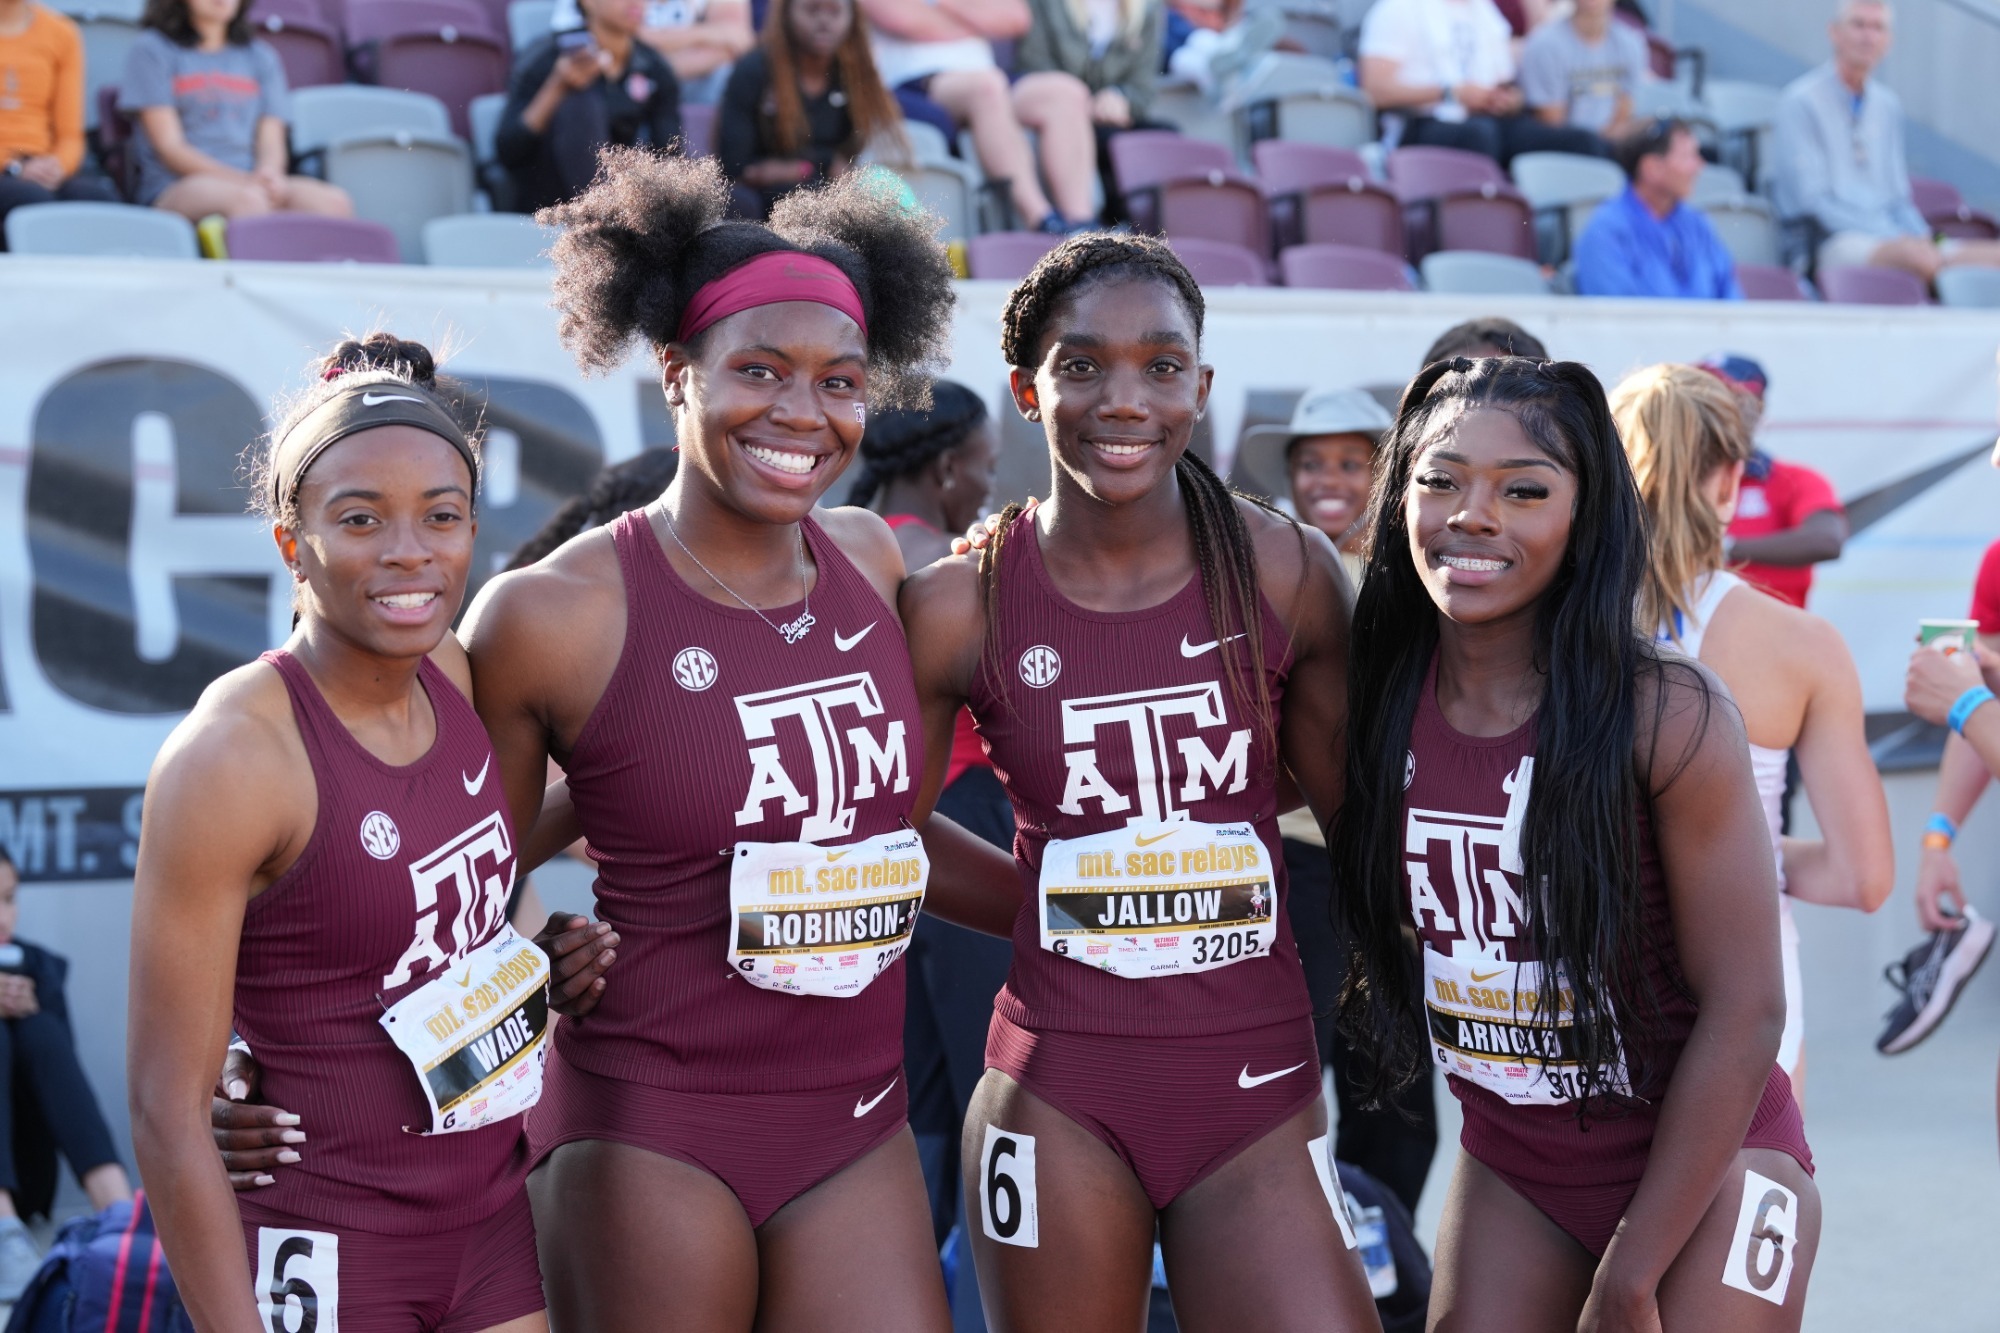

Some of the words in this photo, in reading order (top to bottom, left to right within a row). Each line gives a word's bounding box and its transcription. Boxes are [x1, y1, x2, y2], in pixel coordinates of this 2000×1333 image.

[676, 650, 715, 688] SEC
[1022, 649, 1057, 685] SEC
[364, 814, 398, 856] SEC
[768, 865, 813, 896] mt.
[817, 863, 858, 893] sac
[861, 857, 922, 888] relays
[1078, 851, 1122, 878] mt.
[1126, 851, 1176, 877] sac
[1181, 843, 1259, 875] relays
[763, 904, 905, 946] ROBINSON-
[1097, 889, 1222, 927] JALLOW
[1192, 930, 1259, 964] 3205
[1150, 963, 1180, 971] GARMIN
[426, 1004, 466, 1043] mt.
[462, 986, 500, 1020] sac
[490, 947, 542, 996] relays
[833, 983, 859, 991] GARMIN
[1433, 978, 1468, 1005] mt.
[1469, 986, 1512, 1011] sac
[469, 1007, 534, 1073] WADE
[1504, 1066, 1529, 1074] ULTIMATE
[988, 1137, 1022, 1238] 6
[1746, 1188, 1788, 1291] 6
[270, 1236, 318, 1333] 6
